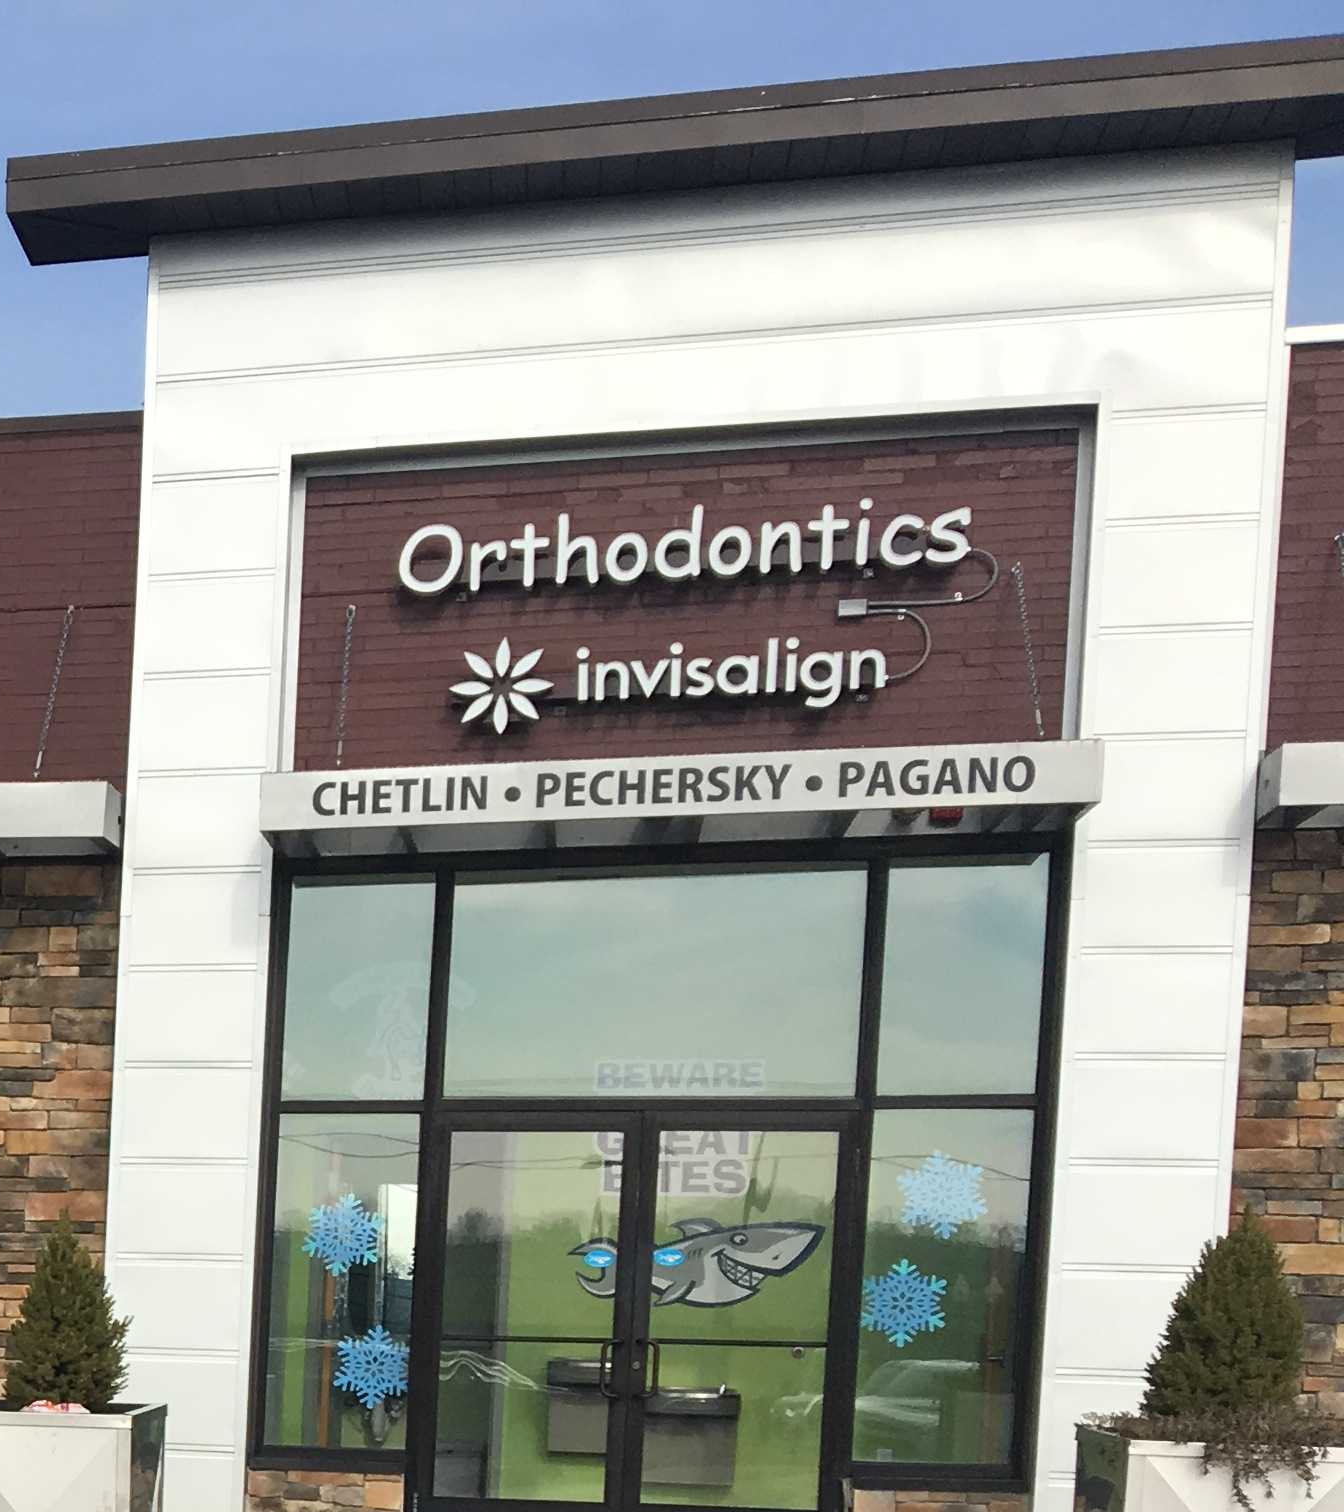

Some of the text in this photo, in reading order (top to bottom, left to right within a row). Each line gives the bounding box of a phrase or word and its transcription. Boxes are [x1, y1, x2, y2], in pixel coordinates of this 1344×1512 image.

[398, 497, 972, 593] Orthodontics
[576, 636, 890, 708] invisalign
[312, 776, 488, 817] CHETLIN
[535, 764, 792, 808] PECHERSKY
[838, 755, 1036, 798] PAGANO
[596, 1061, 763, 1090] BEWARE
[597, 1131, 750, 1156] GEA
[603, 1158, 748, 1195] BTES
